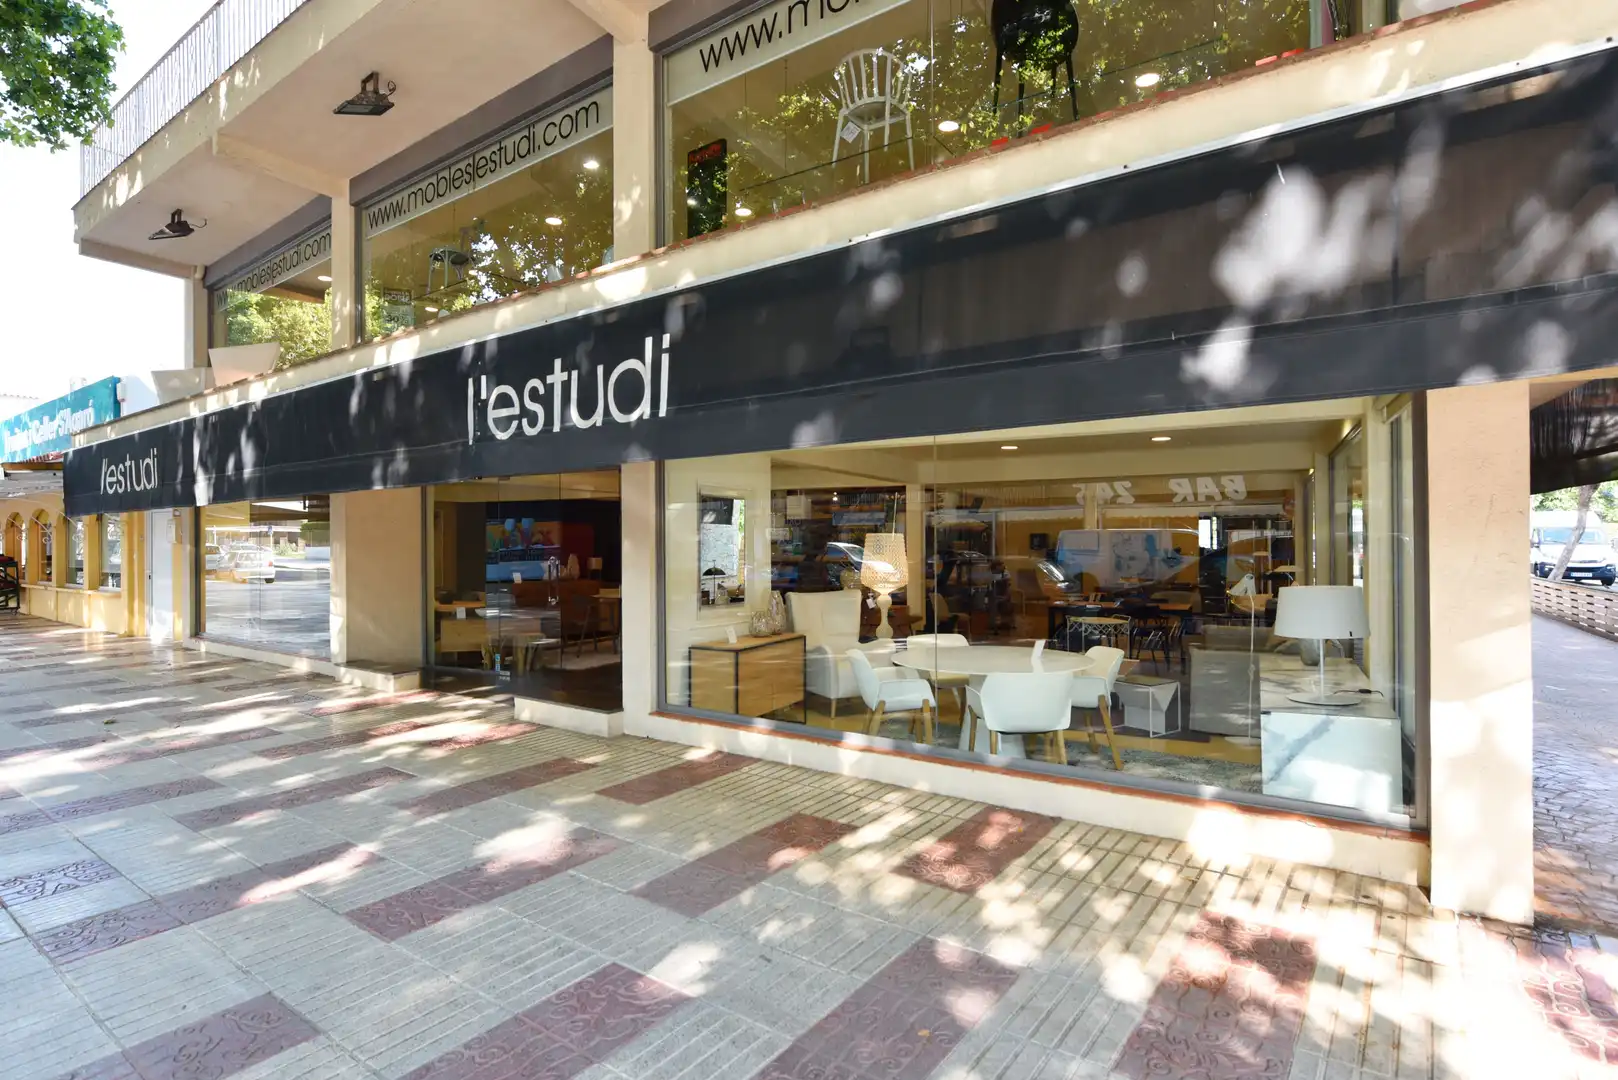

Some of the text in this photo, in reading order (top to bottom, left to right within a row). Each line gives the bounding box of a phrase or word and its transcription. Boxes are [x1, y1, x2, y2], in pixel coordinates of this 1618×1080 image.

[699, 0, 860, 72] www.mo
[467, 333, 671, 446] l'estudi
[100, 447, 158, 495] l'estudi
